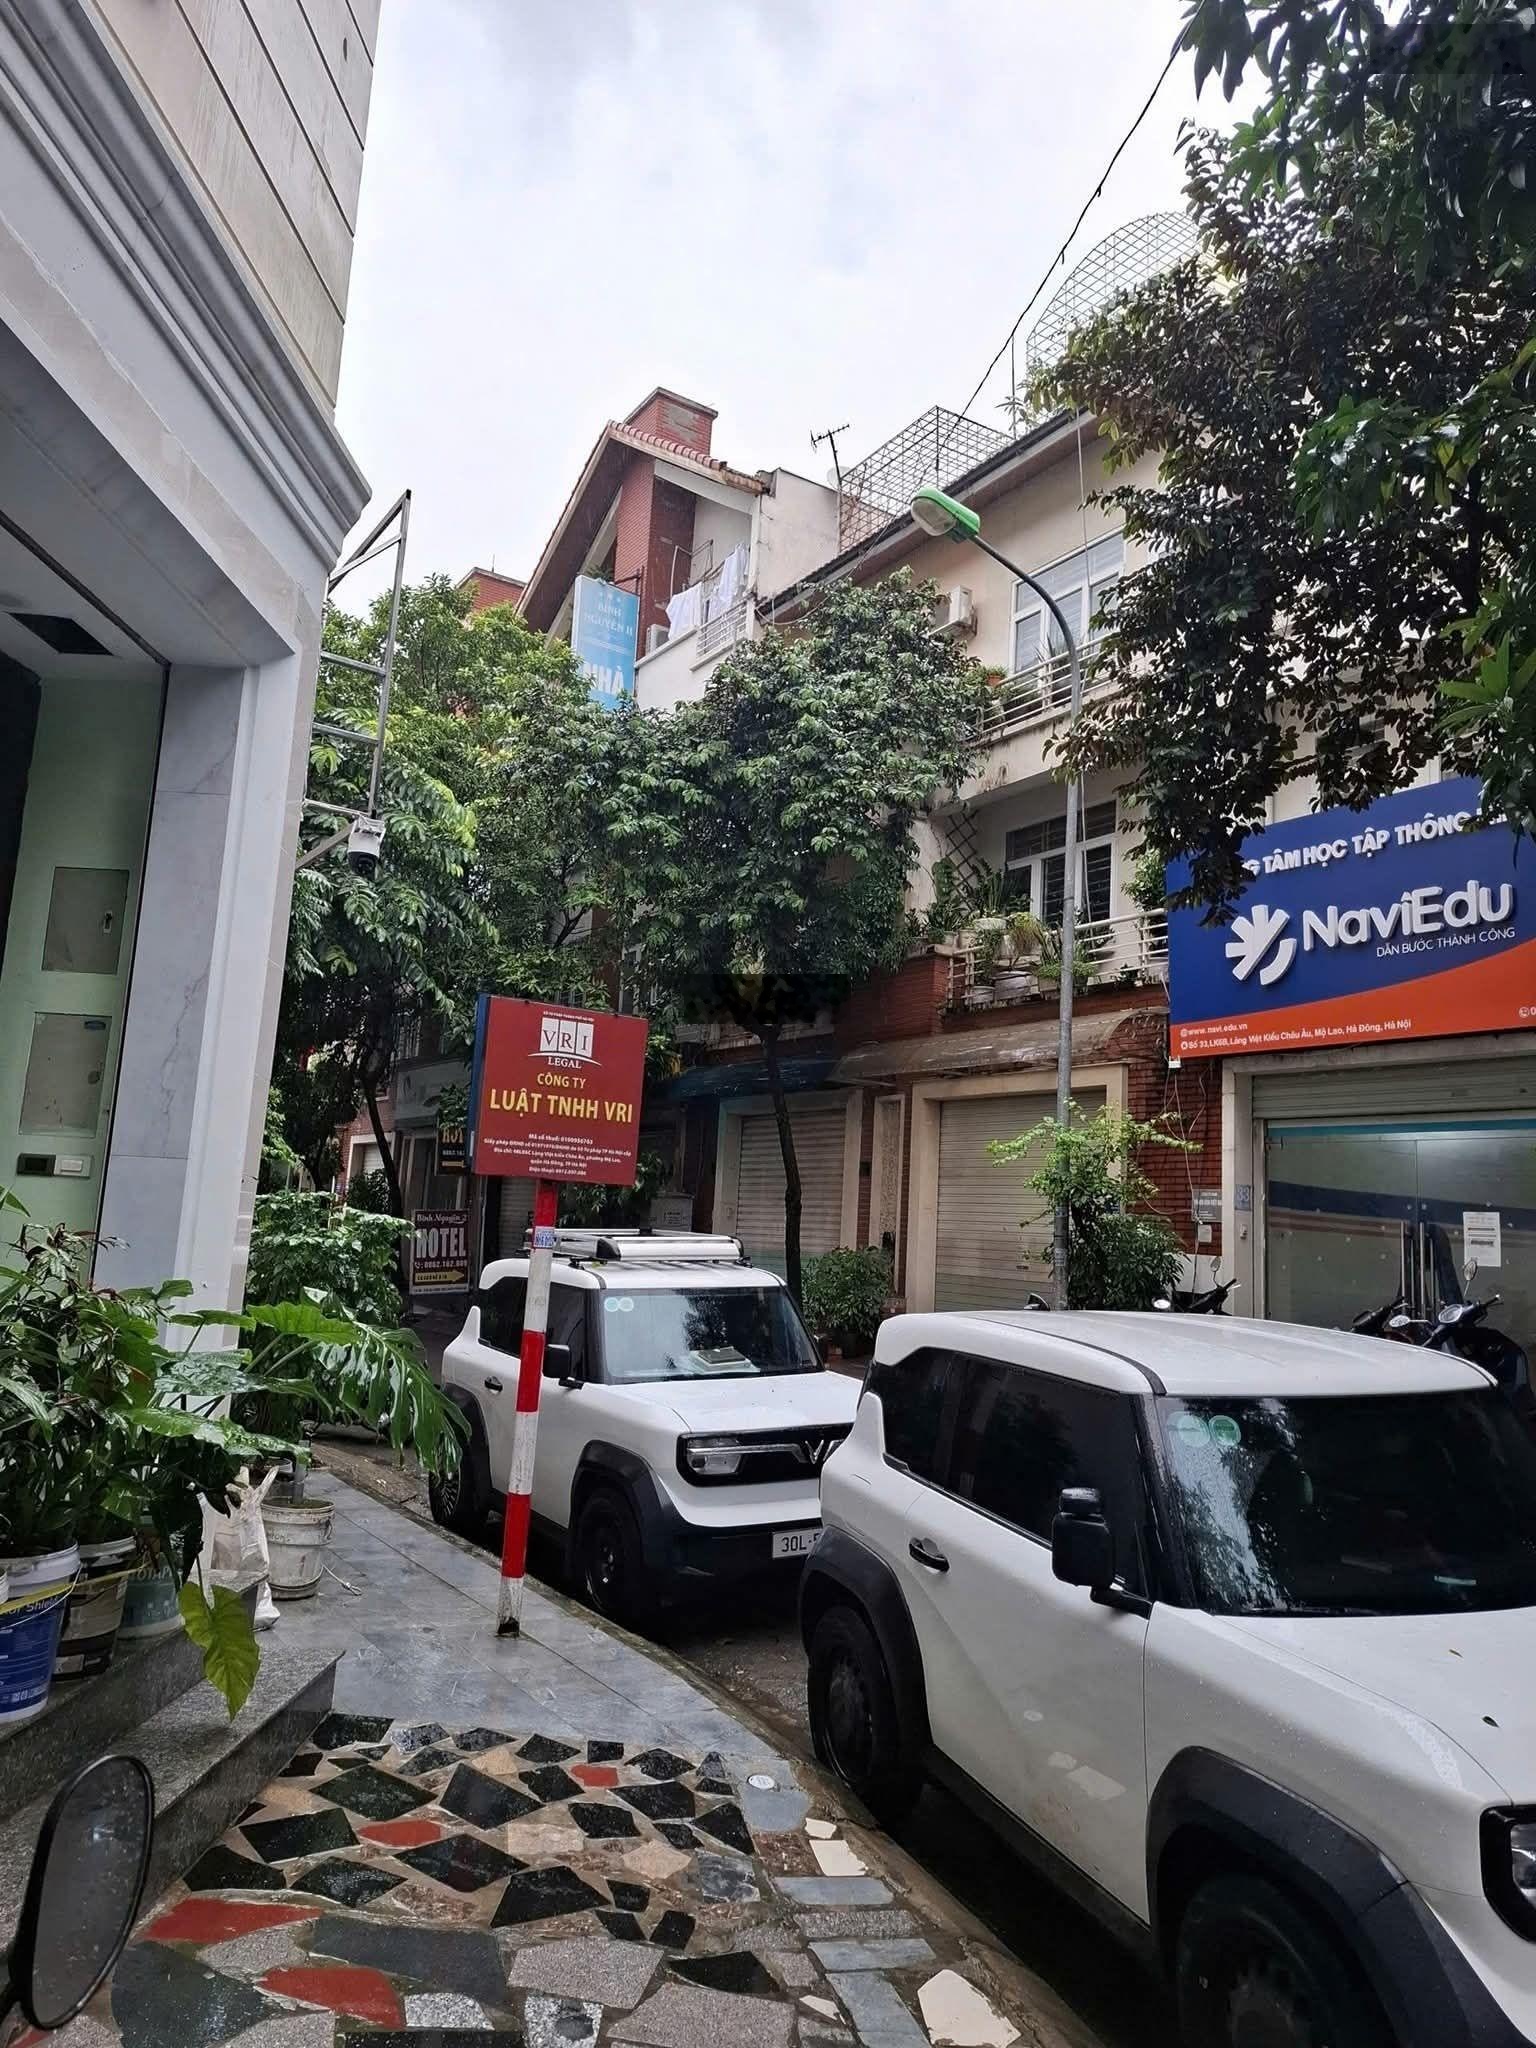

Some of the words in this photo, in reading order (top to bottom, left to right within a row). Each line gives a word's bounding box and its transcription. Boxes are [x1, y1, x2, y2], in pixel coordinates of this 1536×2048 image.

[1262, 848, 1301, 874] TÂM
[1303, 839, 1348, 867] HỌC
[1352, 827, 1391, 857] TẬP
[1394, 812, 1472, 845] THÔNG
[1376, 940, 1400, 957] DẪN
[1402, 936, 1434, 953] BƯỚC
[1437, 931, 1477, 948] THÀNH
[1479, 926, 1516, 943] CÔNG
[543, 1029, 588, 1051] VRI
[547, 1056, 582, 1069] LEGAL
[537, 1071, 569, 1088] CÔNG
[572, 1076, 587, 1089] TY
[490, 1087, 542, 1118] LUẬT
[547, 1094, 599, 1119] TNHH
[604, 1100, 633, 1123] VRI
[416, 1227, 466, 1258] HOTEL
